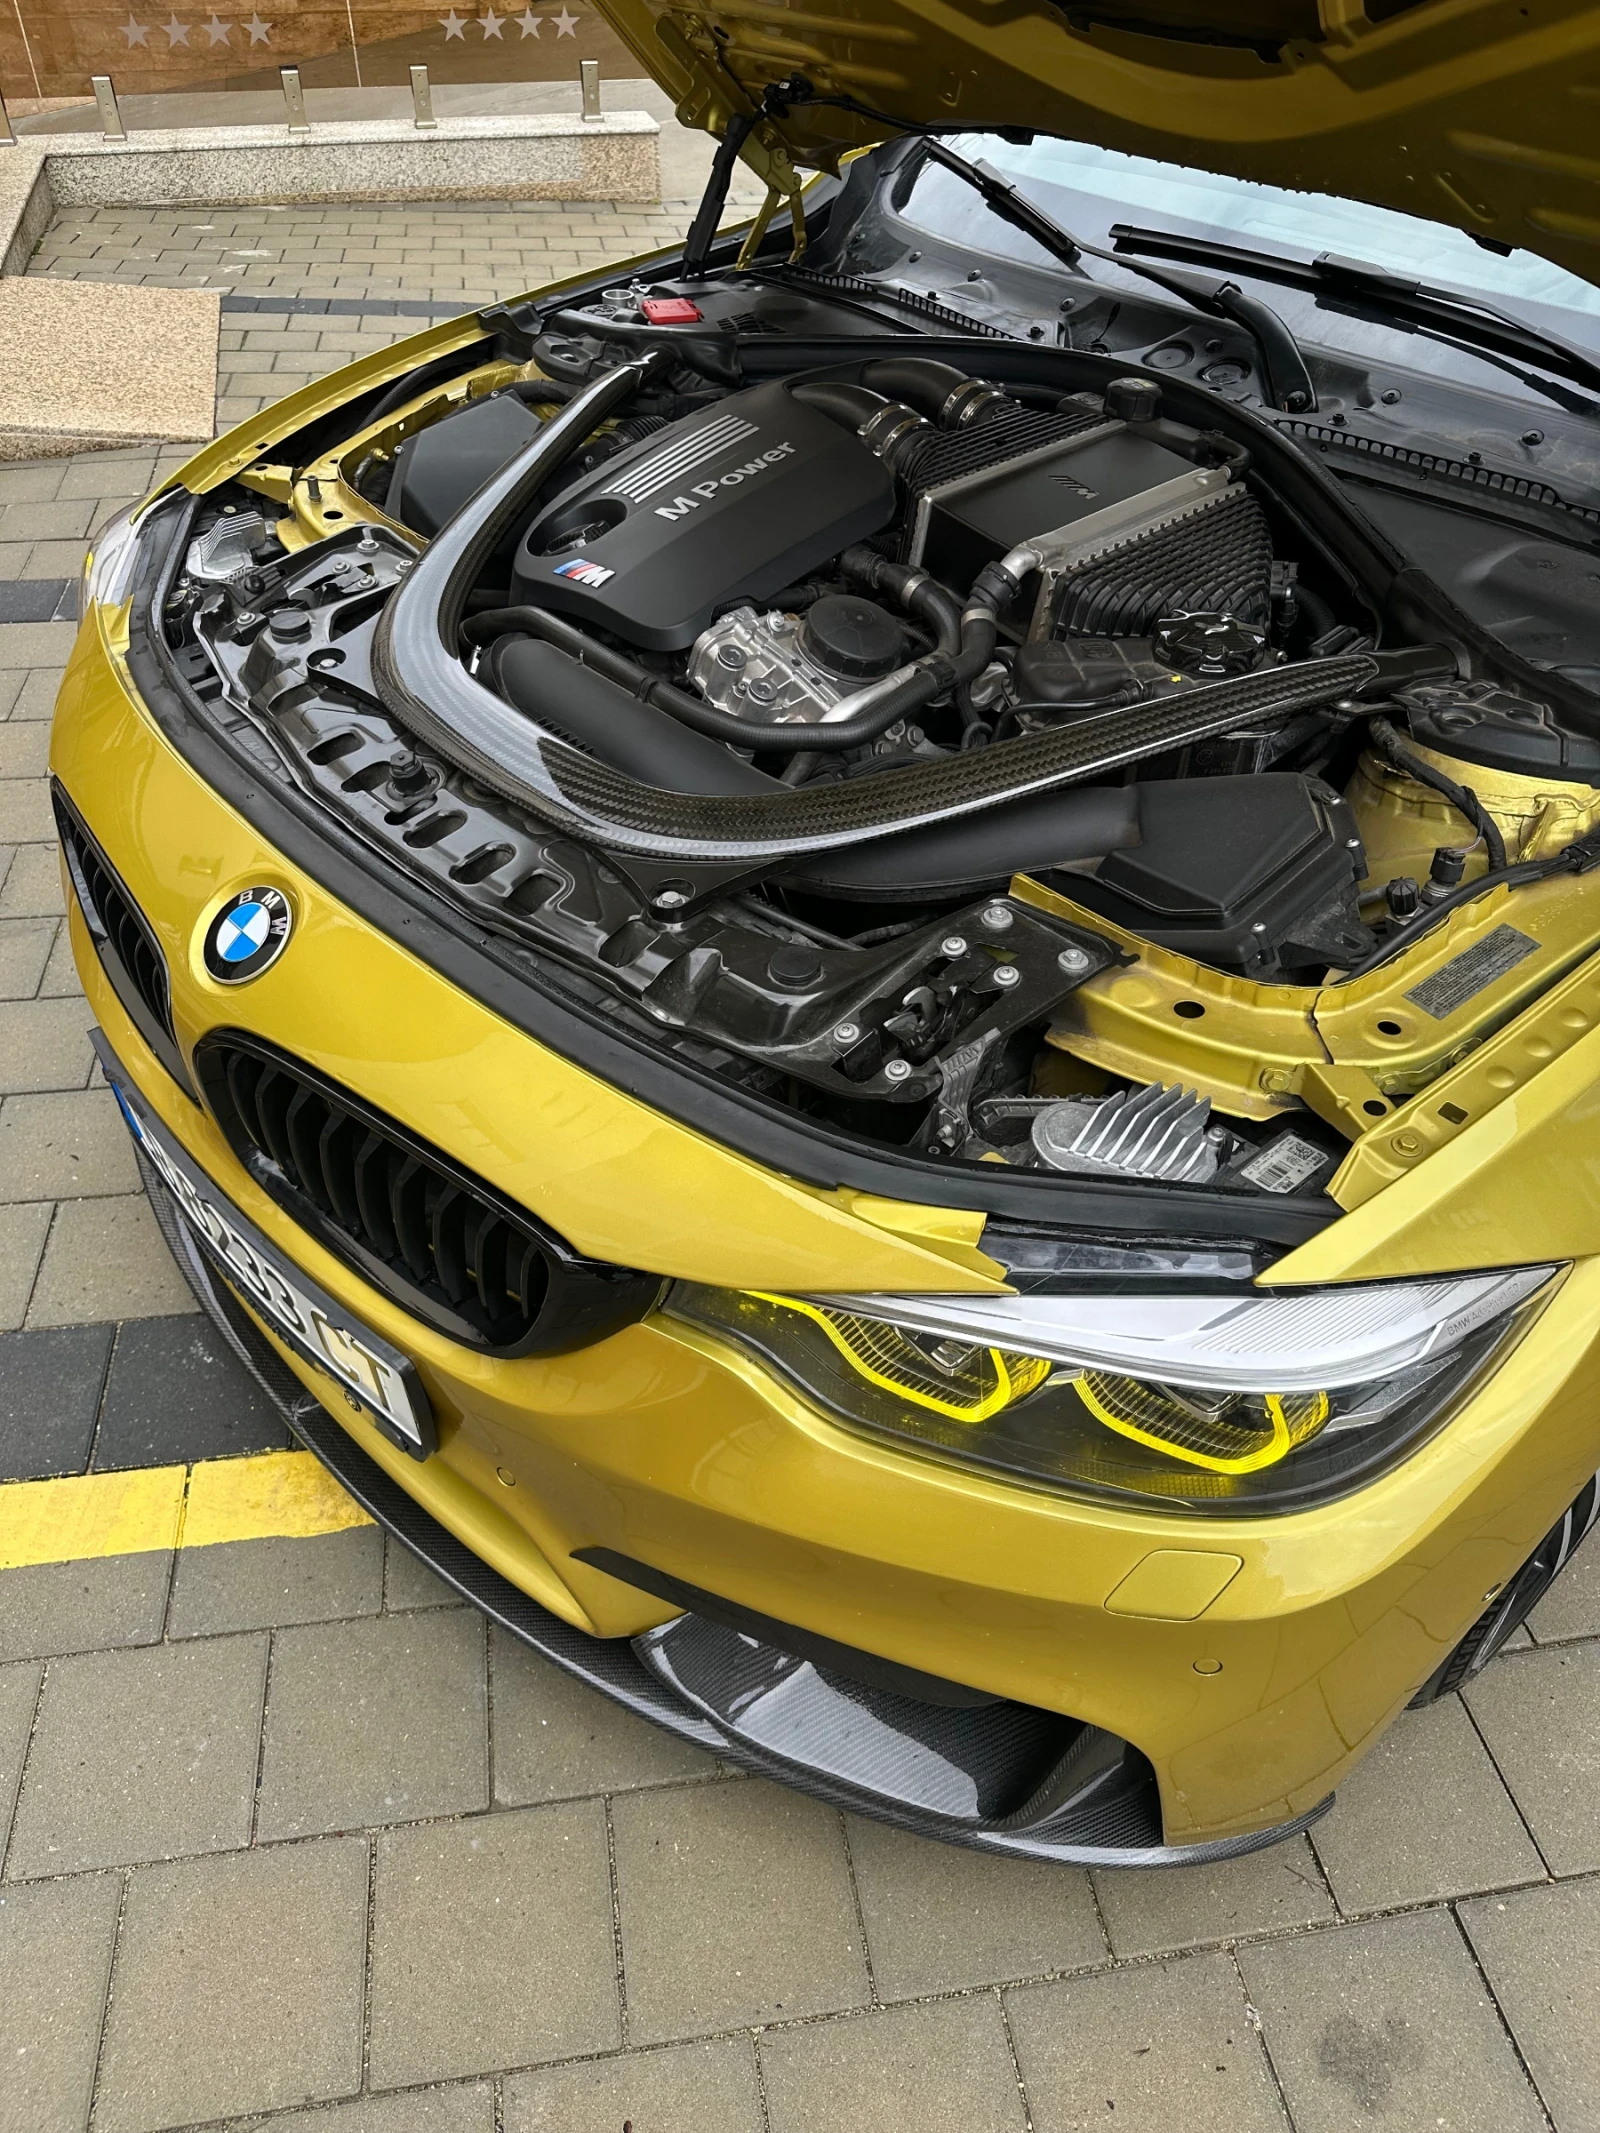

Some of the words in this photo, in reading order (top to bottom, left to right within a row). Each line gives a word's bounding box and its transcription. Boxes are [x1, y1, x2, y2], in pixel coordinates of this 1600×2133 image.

[653, 496, 701, 521] M
[690, 441, 796, 499] Power
[238, 889, 287, 936] BMW
[1446, 1316, 1471, 1336] BMW
[1504, 1282, 1520, 1299] LED
